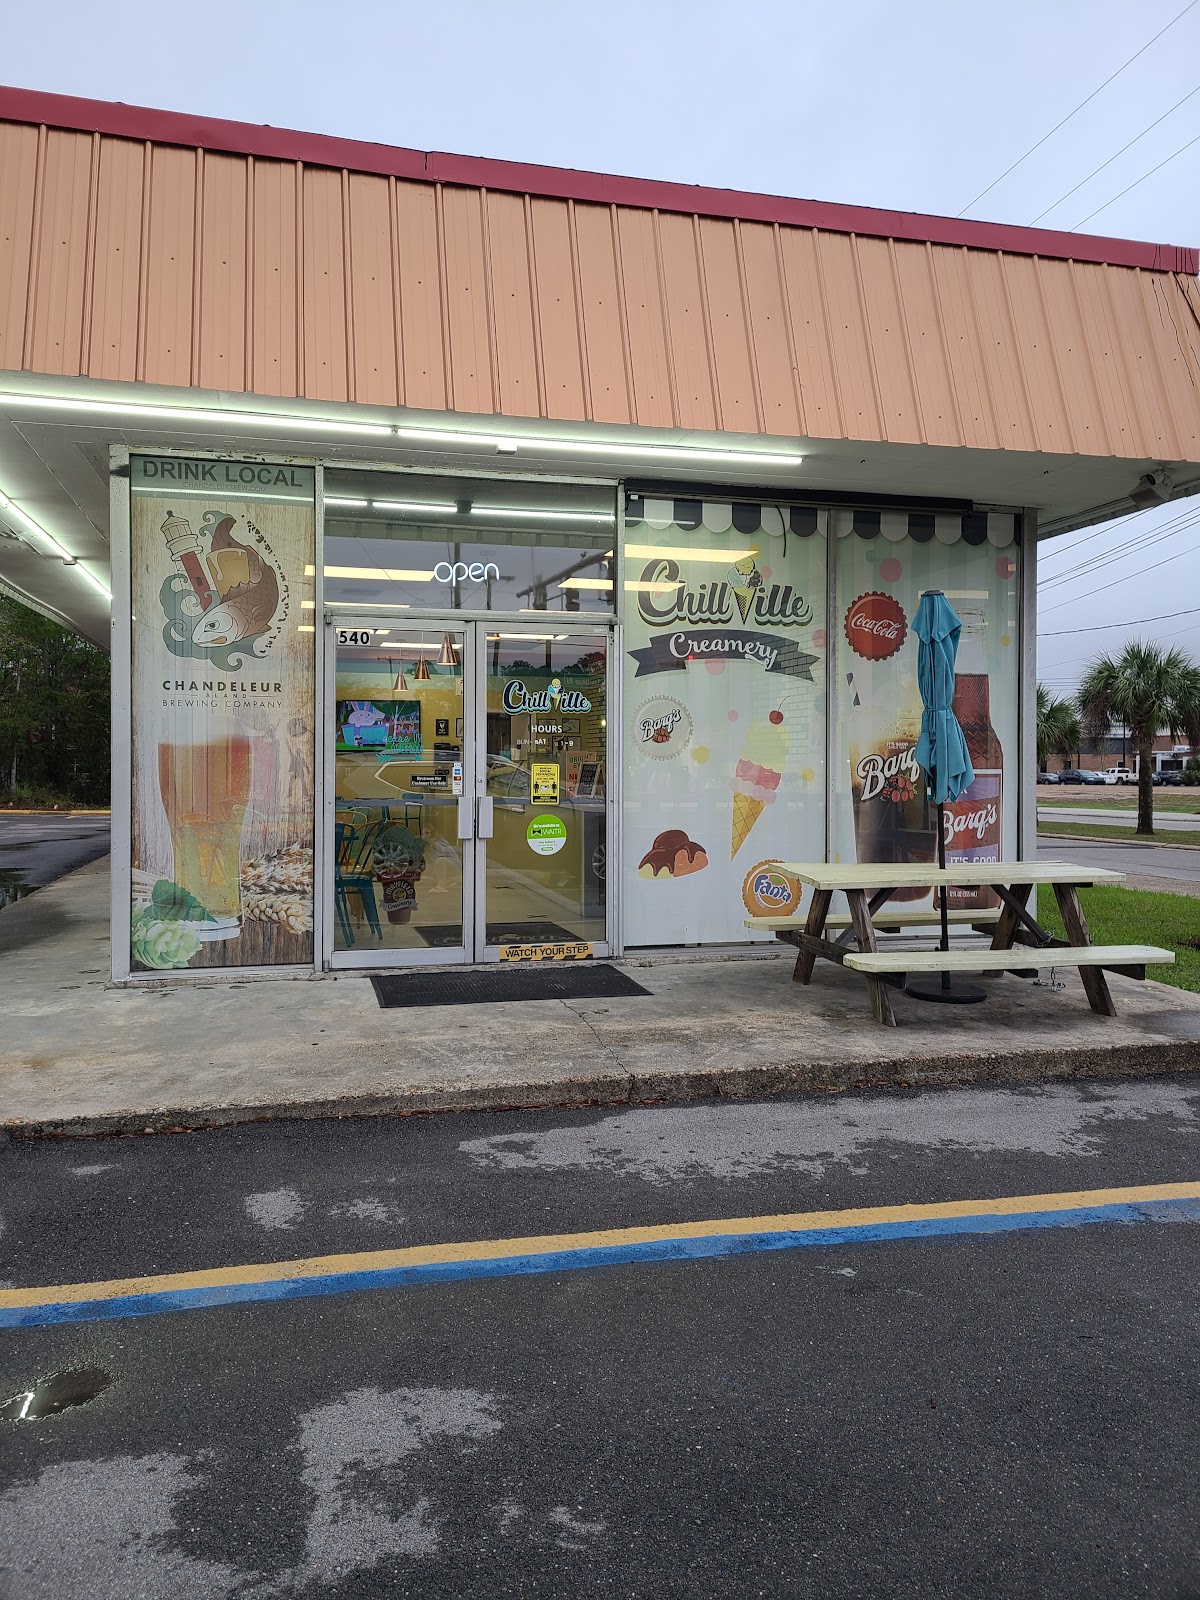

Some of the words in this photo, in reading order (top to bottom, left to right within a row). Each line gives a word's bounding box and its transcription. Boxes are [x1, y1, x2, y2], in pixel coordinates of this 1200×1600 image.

[143, 460, 218, 482] DRINK
[225, 465, 303, 488] LOCAL
[433, 561, 500, 587] open
[338, 630, 370, 645] 540
[669, 632, 778, 670] Creamery
[162, 680, 282, 693] CHANDELEUR
[162, 699, 218, 708] BREWING
[225, 700, 282, 709] COMPANY
[531, 725, 563, 733] HOURS
[640, 708, 682, 743] Barq's
[857, 747, 920, 801] Barq
[943, 803, 997, 845] Barq's
[385, 880, 414, 895] MAYFIELD
[754, 873, 792, 905] Fanta
[505, 948, 537, 958] WATCH
[539, 947, 565, 956] YOUR
[566, 946, 589, 954] STEP
